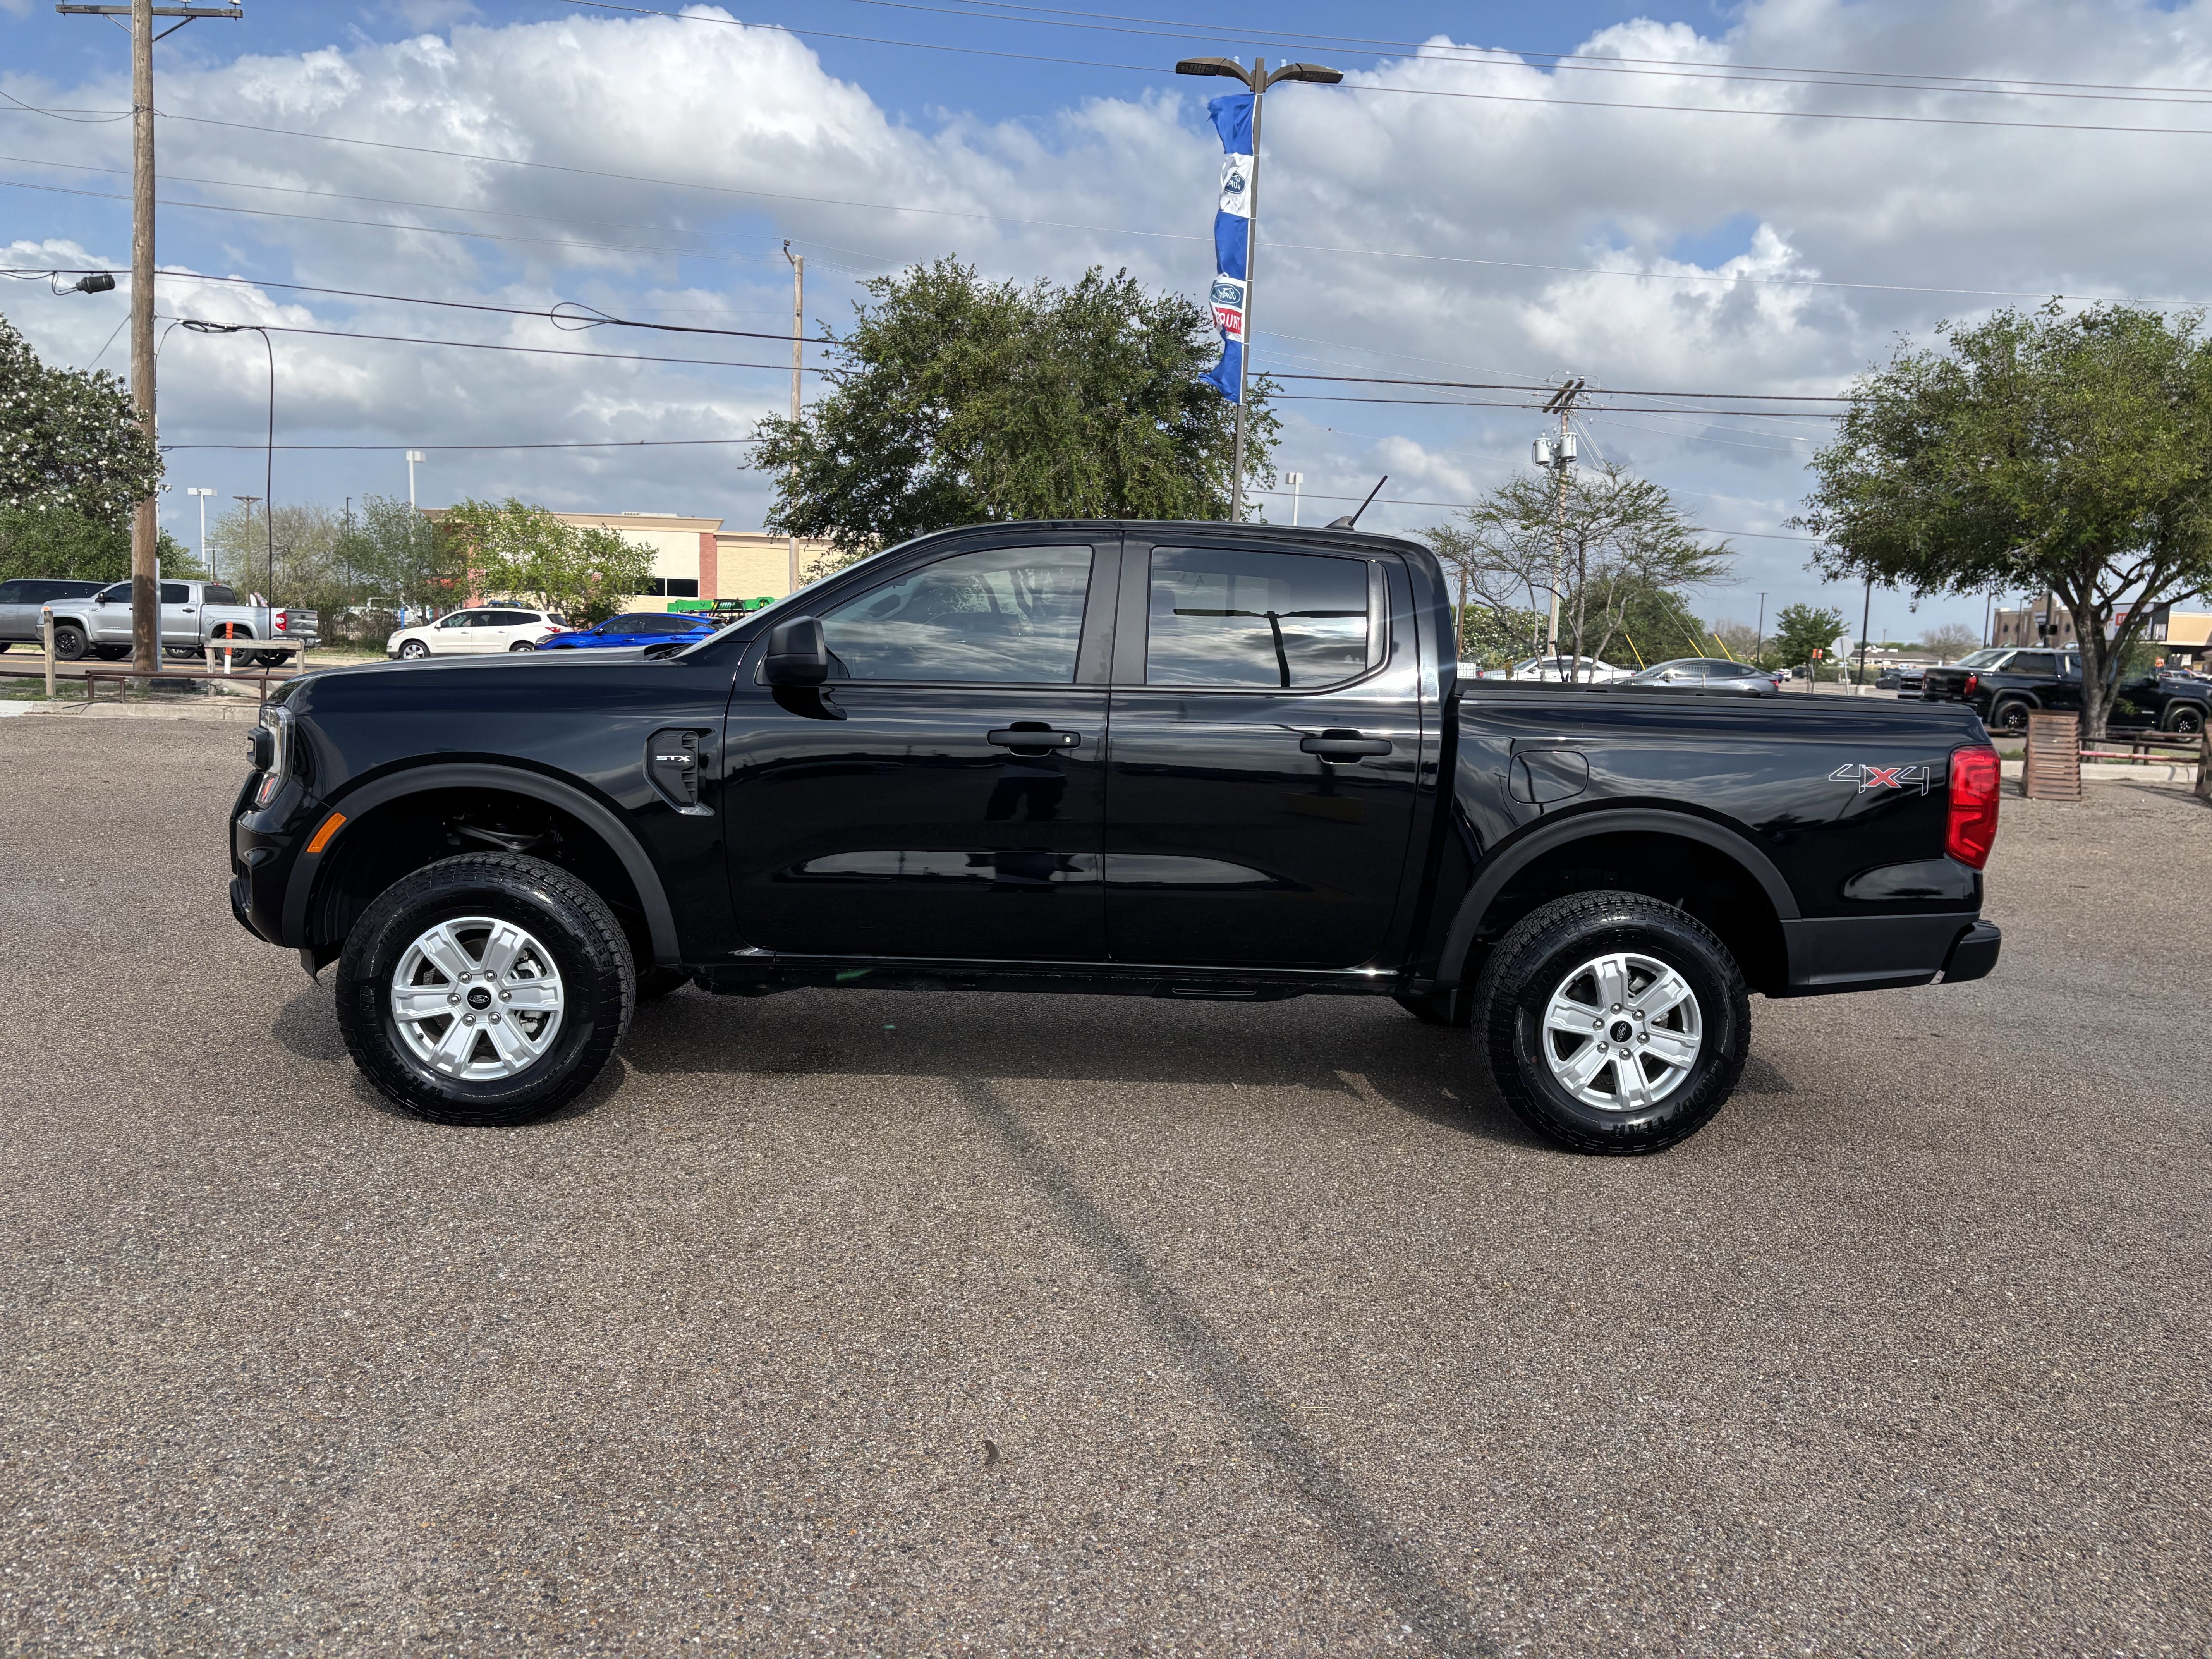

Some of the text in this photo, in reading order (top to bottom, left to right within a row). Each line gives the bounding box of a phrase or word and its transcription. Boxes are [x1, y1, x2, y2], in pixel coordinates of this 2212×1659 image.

[505, 898, 590, 1019] GOODYEAR
[359, 985, 445, 1104] WRANGLER
[1610, 1059, 1723, 1138] GOODYEAR
